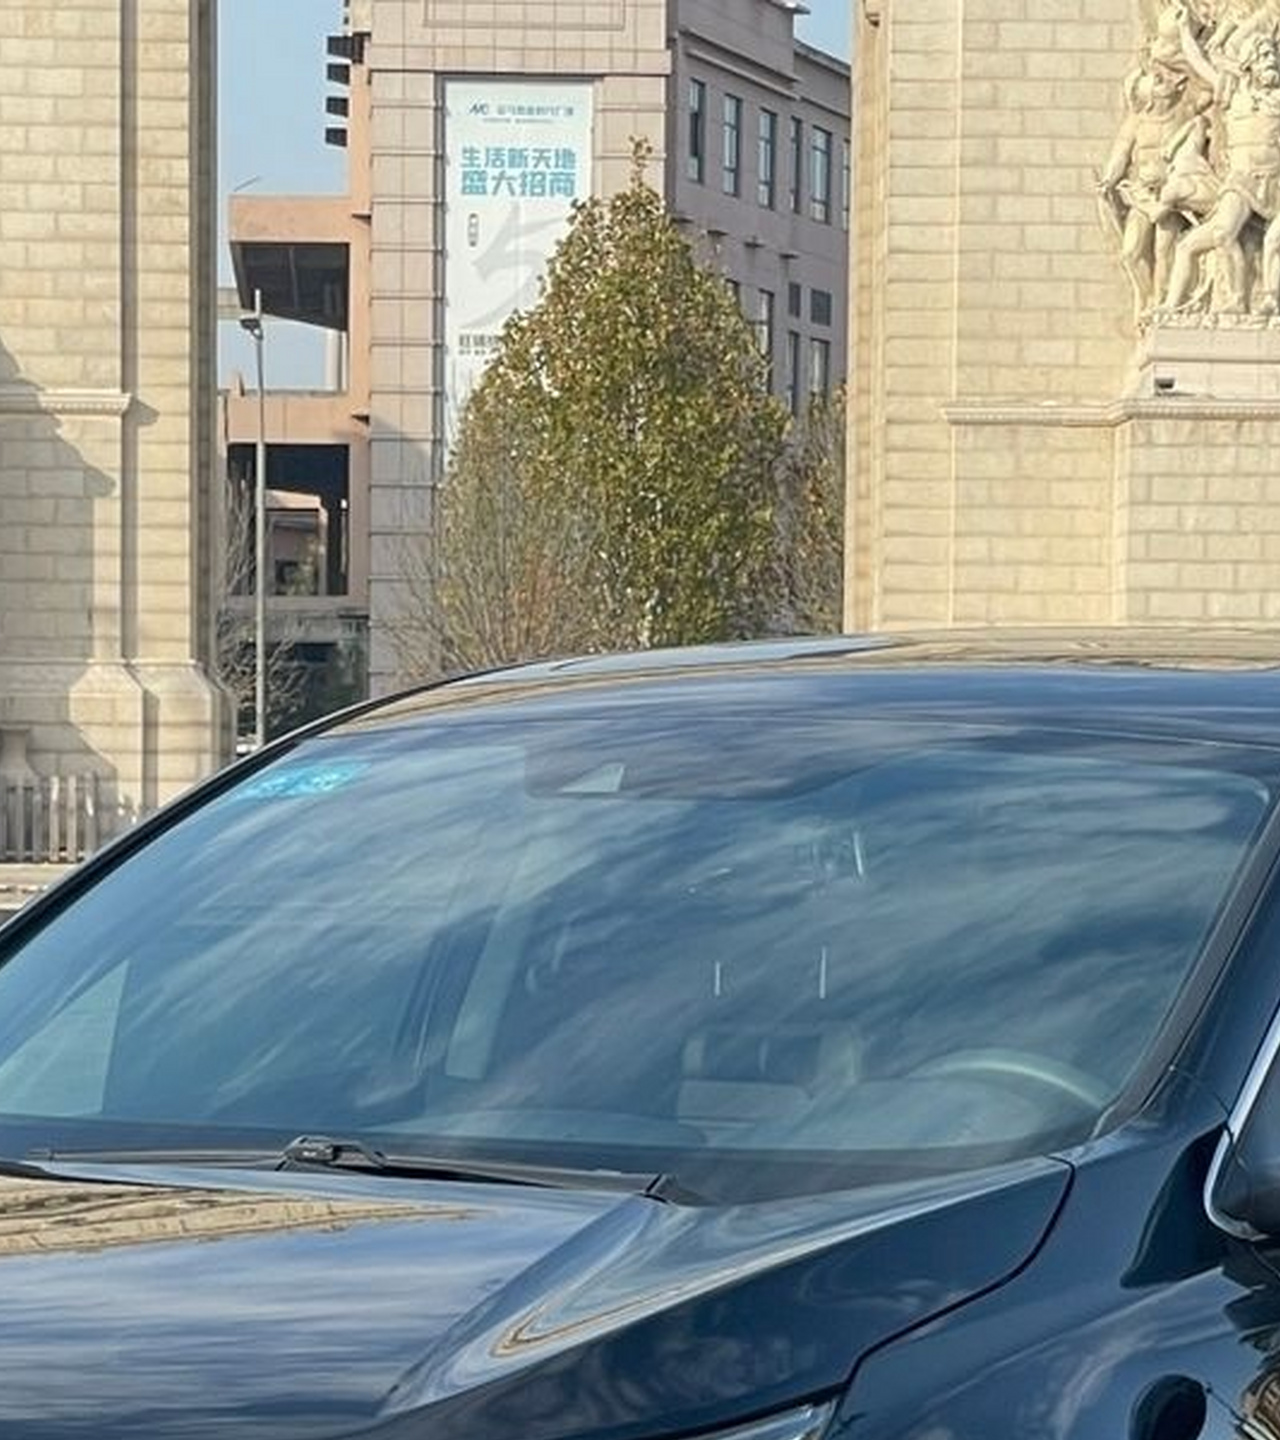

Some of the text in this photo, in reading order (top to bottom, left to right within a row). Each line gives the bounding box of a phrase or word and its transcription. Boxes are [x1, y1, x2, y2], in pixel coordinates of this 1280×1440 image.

[461, 147, 576, 168] 生活新天地
[461, 170, 576, 196] 盛大招商
